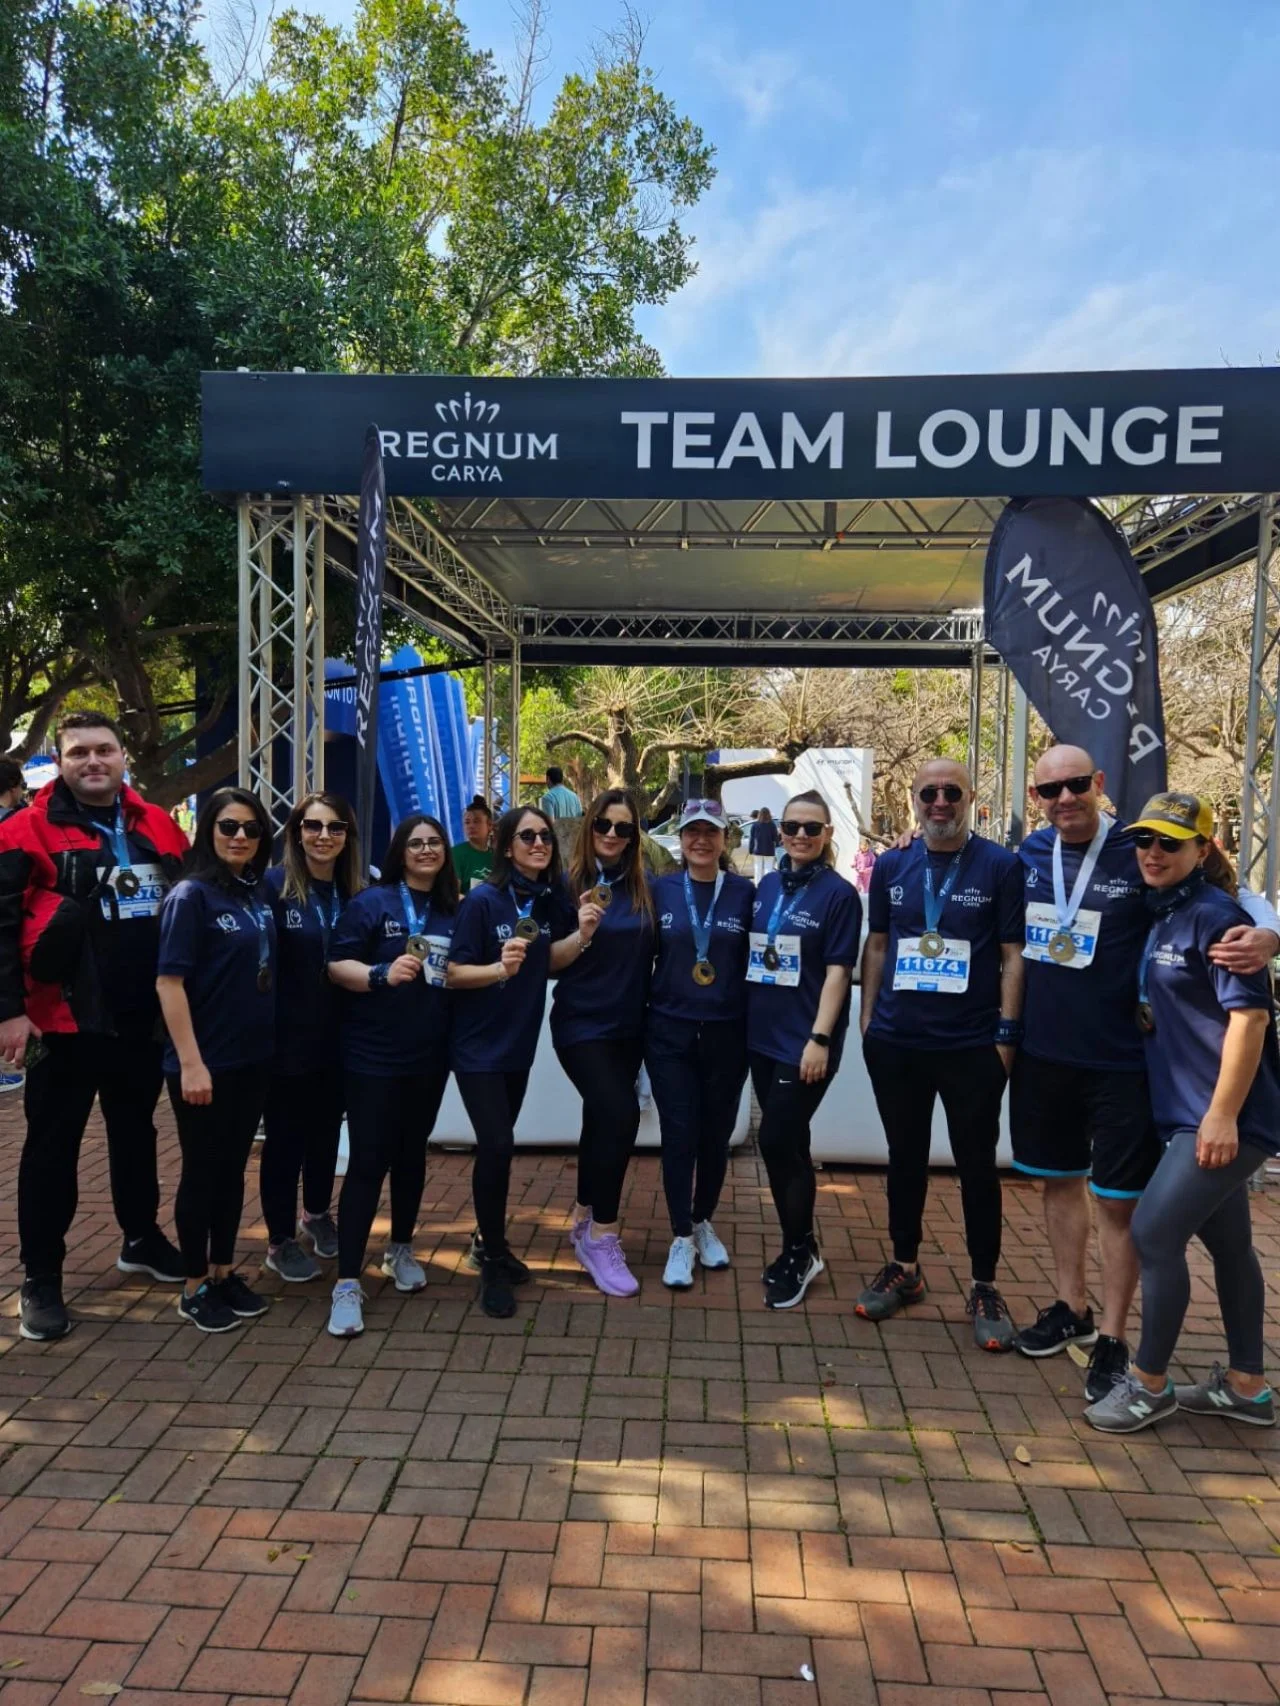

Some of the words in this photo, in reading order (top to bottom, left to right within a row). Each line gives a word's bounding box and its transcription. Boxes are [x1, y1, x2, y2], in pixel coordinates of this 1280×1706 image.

[379, 430, 558, 460] REGNUM
[621, 411, 844, 469] TEAM
[875, 405, 1224, 469] LOUNGE
[431, 464, 503, 482] CARYA
[951, 894, 992, 903] REGNUM
[1030, 927, 1085, 948] 1163
[902, 958, 959, 972] 11674
